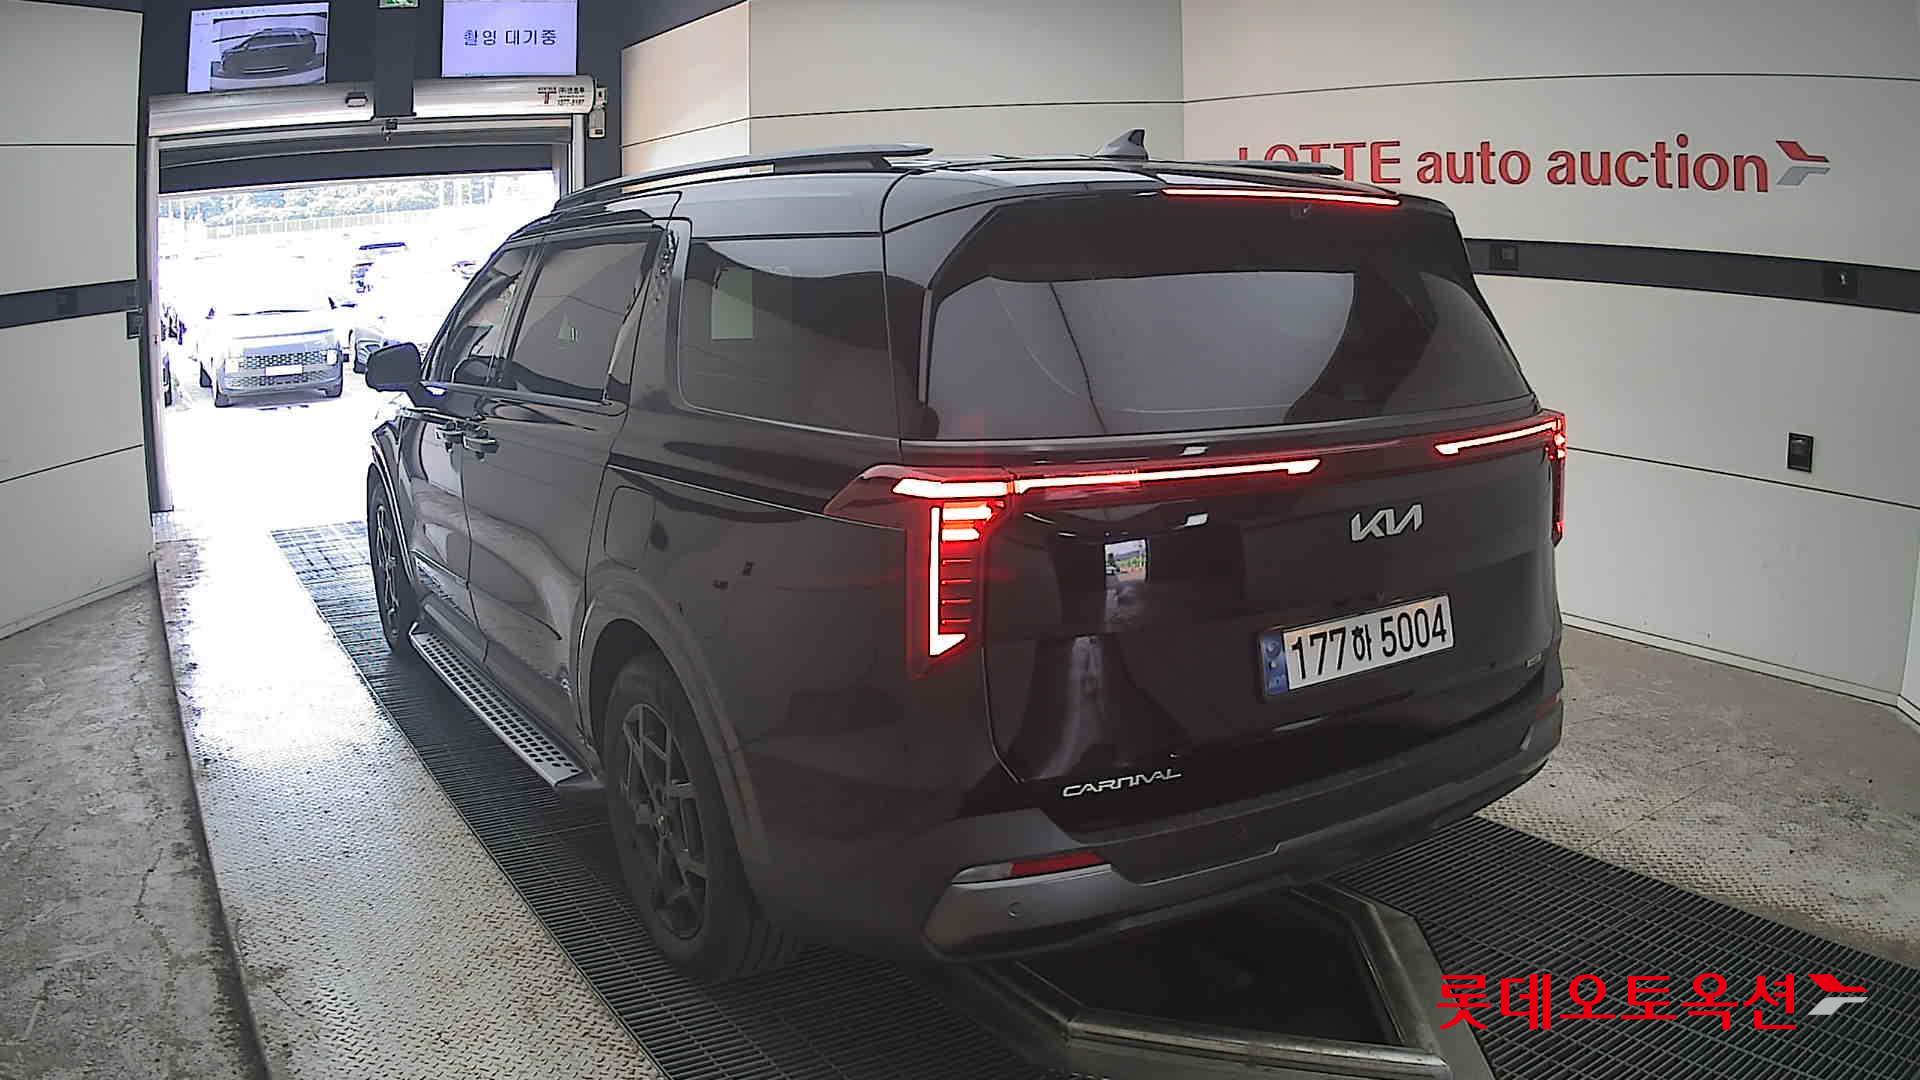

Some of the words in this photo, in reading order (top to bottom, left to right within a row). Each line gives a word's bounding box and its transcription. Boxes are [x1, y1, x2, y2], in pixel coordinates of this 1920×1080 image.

[505, 29, 558, 47] 대기중
[1416, 141, 1532, 186] auto
[1546, 133, 1769, 192] auction
[1290, 623, 1373, 680] 177하
[1380, 603, 1448, 659] 5004
[1062, 768, 1183, 798] CARNIVAL
